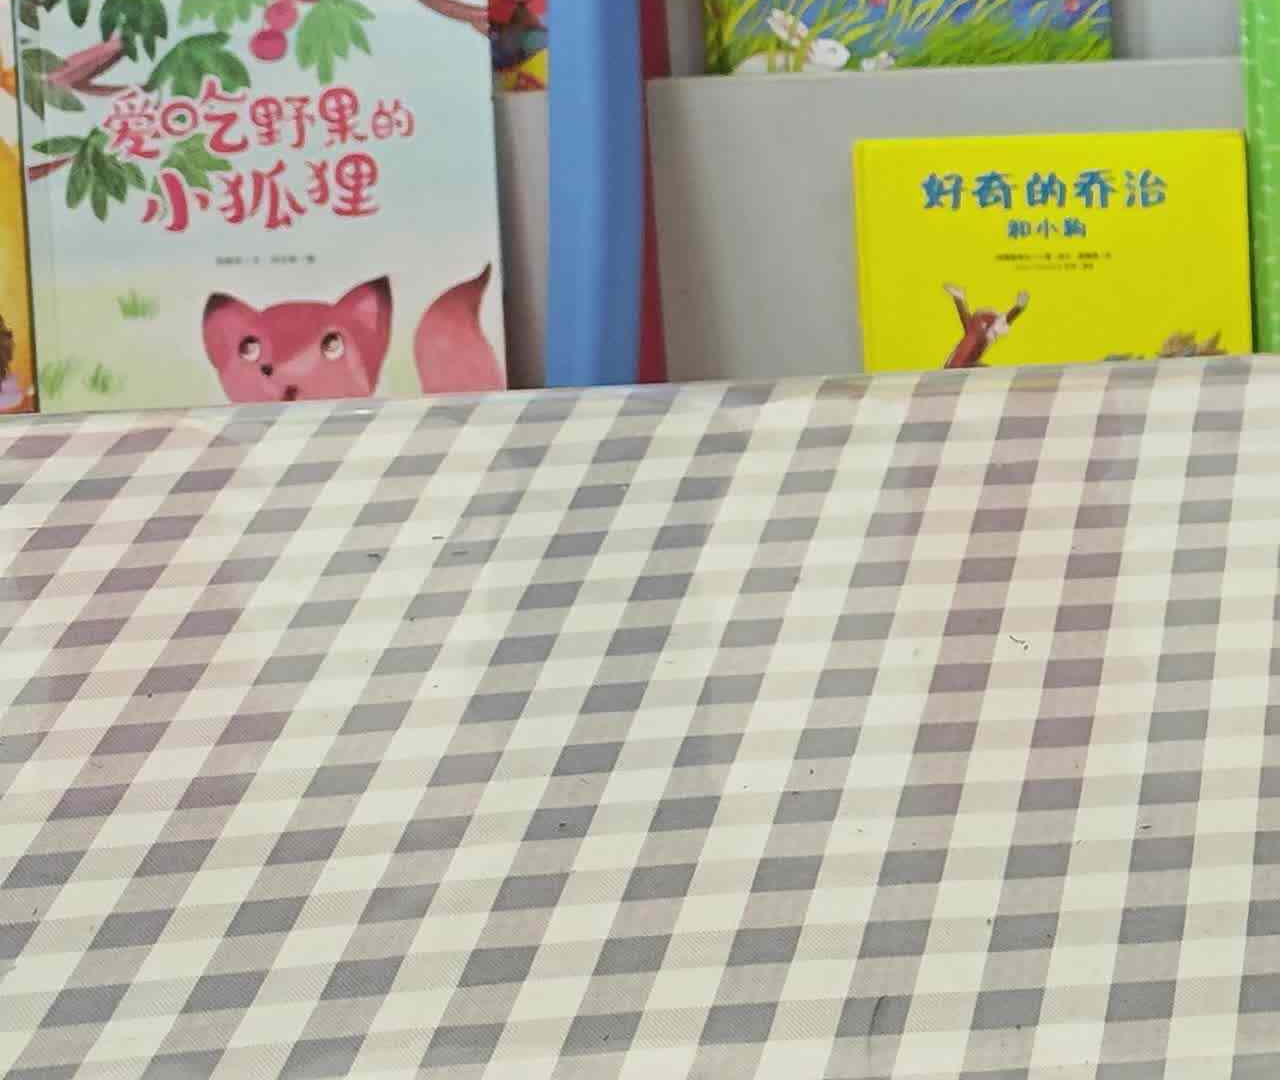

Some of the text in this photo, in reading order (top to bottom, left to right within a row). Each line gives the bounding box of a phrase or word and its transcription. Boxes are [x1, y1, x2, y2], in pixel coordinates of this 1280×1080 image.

[102, 79, 416, 159] 爱吃野果的
[141, 151, 382, 233] 小狐狸
[920, 168, 1169, 211] 好奇的乔治
[1006, 216, 1088, 240] 和小狗
